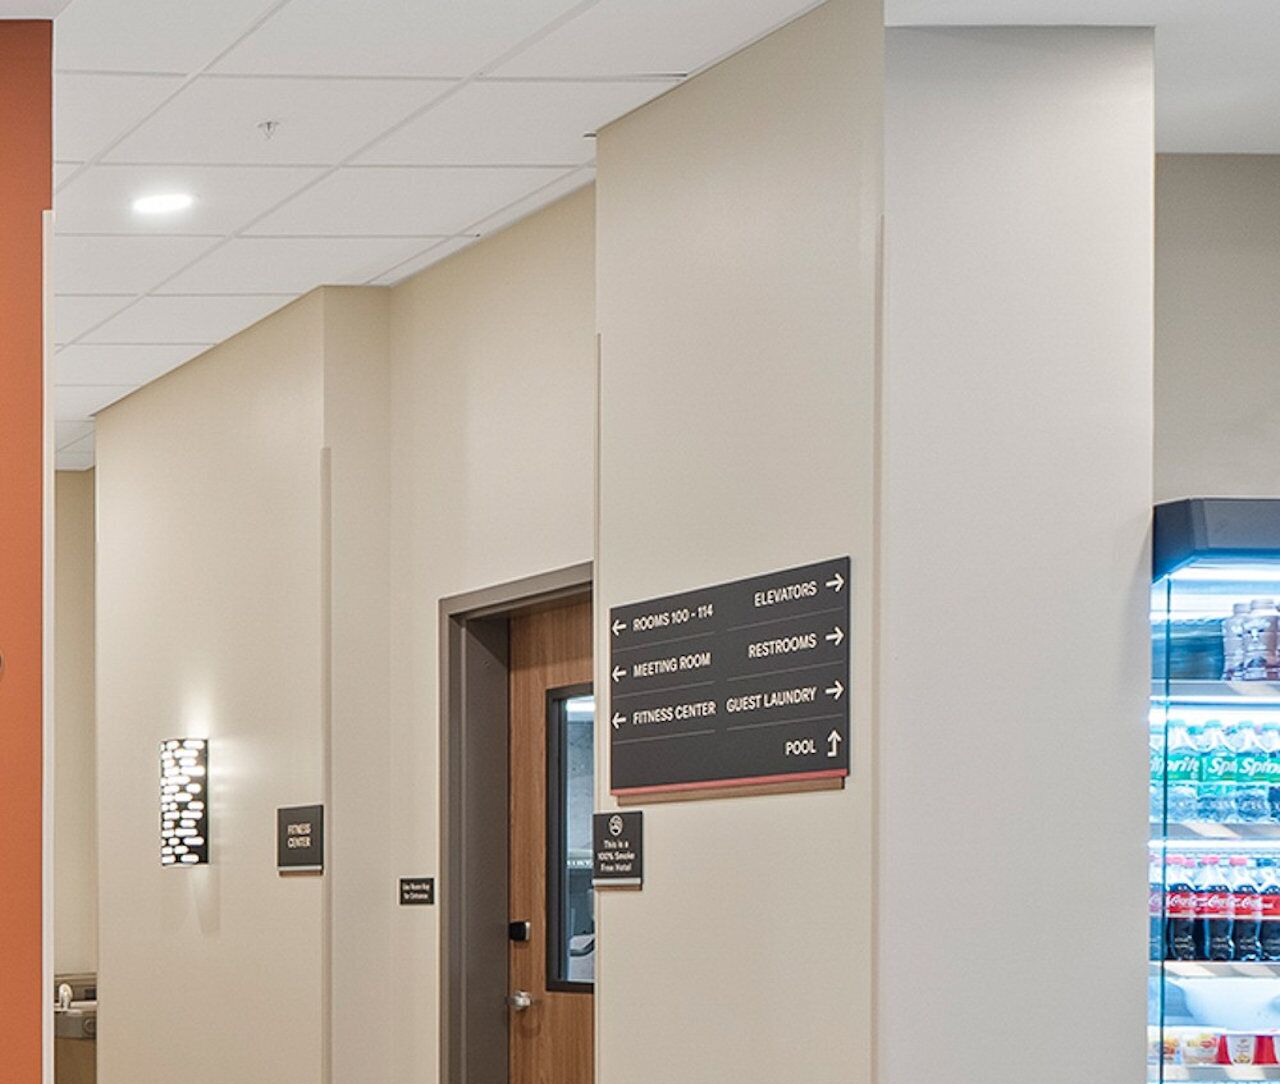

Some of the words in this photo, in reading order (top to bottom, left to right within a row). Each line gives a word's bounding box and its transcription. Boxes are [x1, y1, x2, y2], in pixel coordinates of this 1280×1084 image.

[754, 581, 818, 607] ELEVATORS
[633, 613, 670, 631] ROOMS
[671, 609, 690, 624] 100
[698, 604, 714, 619] 114
[748, 633, 818, 658] RESTROOMS
[633, 658, 678, 677] MEETING
[679, 653, 711, 670] ROOM
[727, 694, 762, 712] GUEST
[764, 687, 818, 709] LAUNDRY
[633, 707, 675, 724] FITNESS
[675, 701, 717, 720] CENTER
[785, 740, 817, 755] POOL
